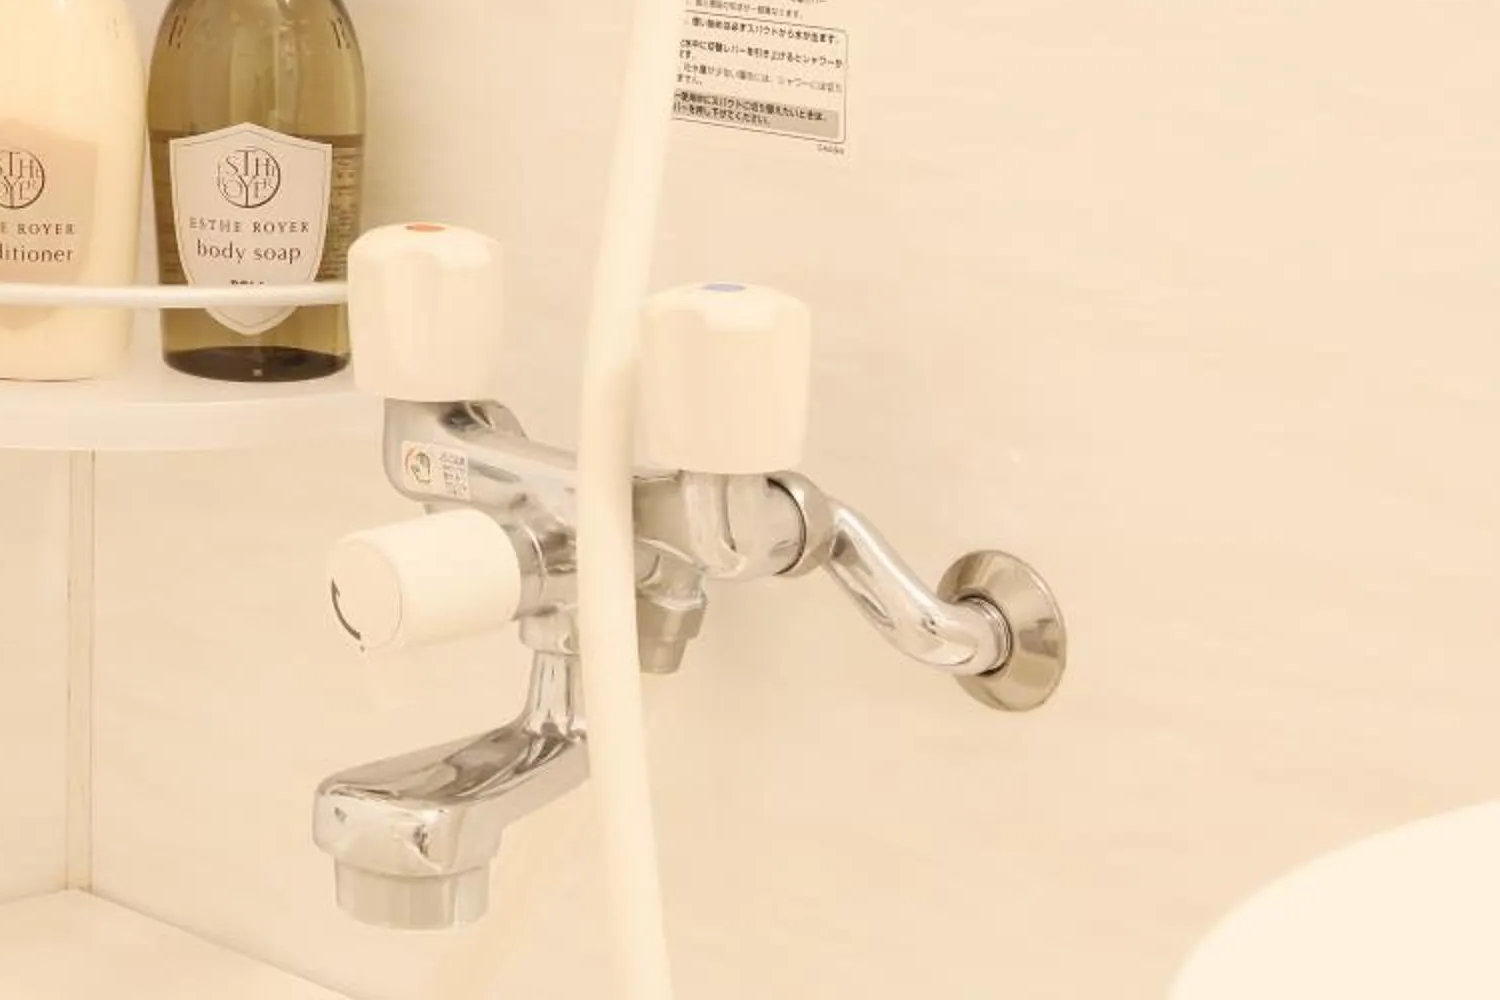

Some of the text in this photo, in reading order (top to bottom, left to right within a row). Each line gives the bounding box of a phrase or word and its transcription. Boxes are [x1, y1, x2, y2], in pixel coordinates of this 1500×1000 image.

[17, 223, 75, 235] ROYER
[189, 216, 309, 233] ESTHE ROYER
[197, 239, 301, 265] body soap
